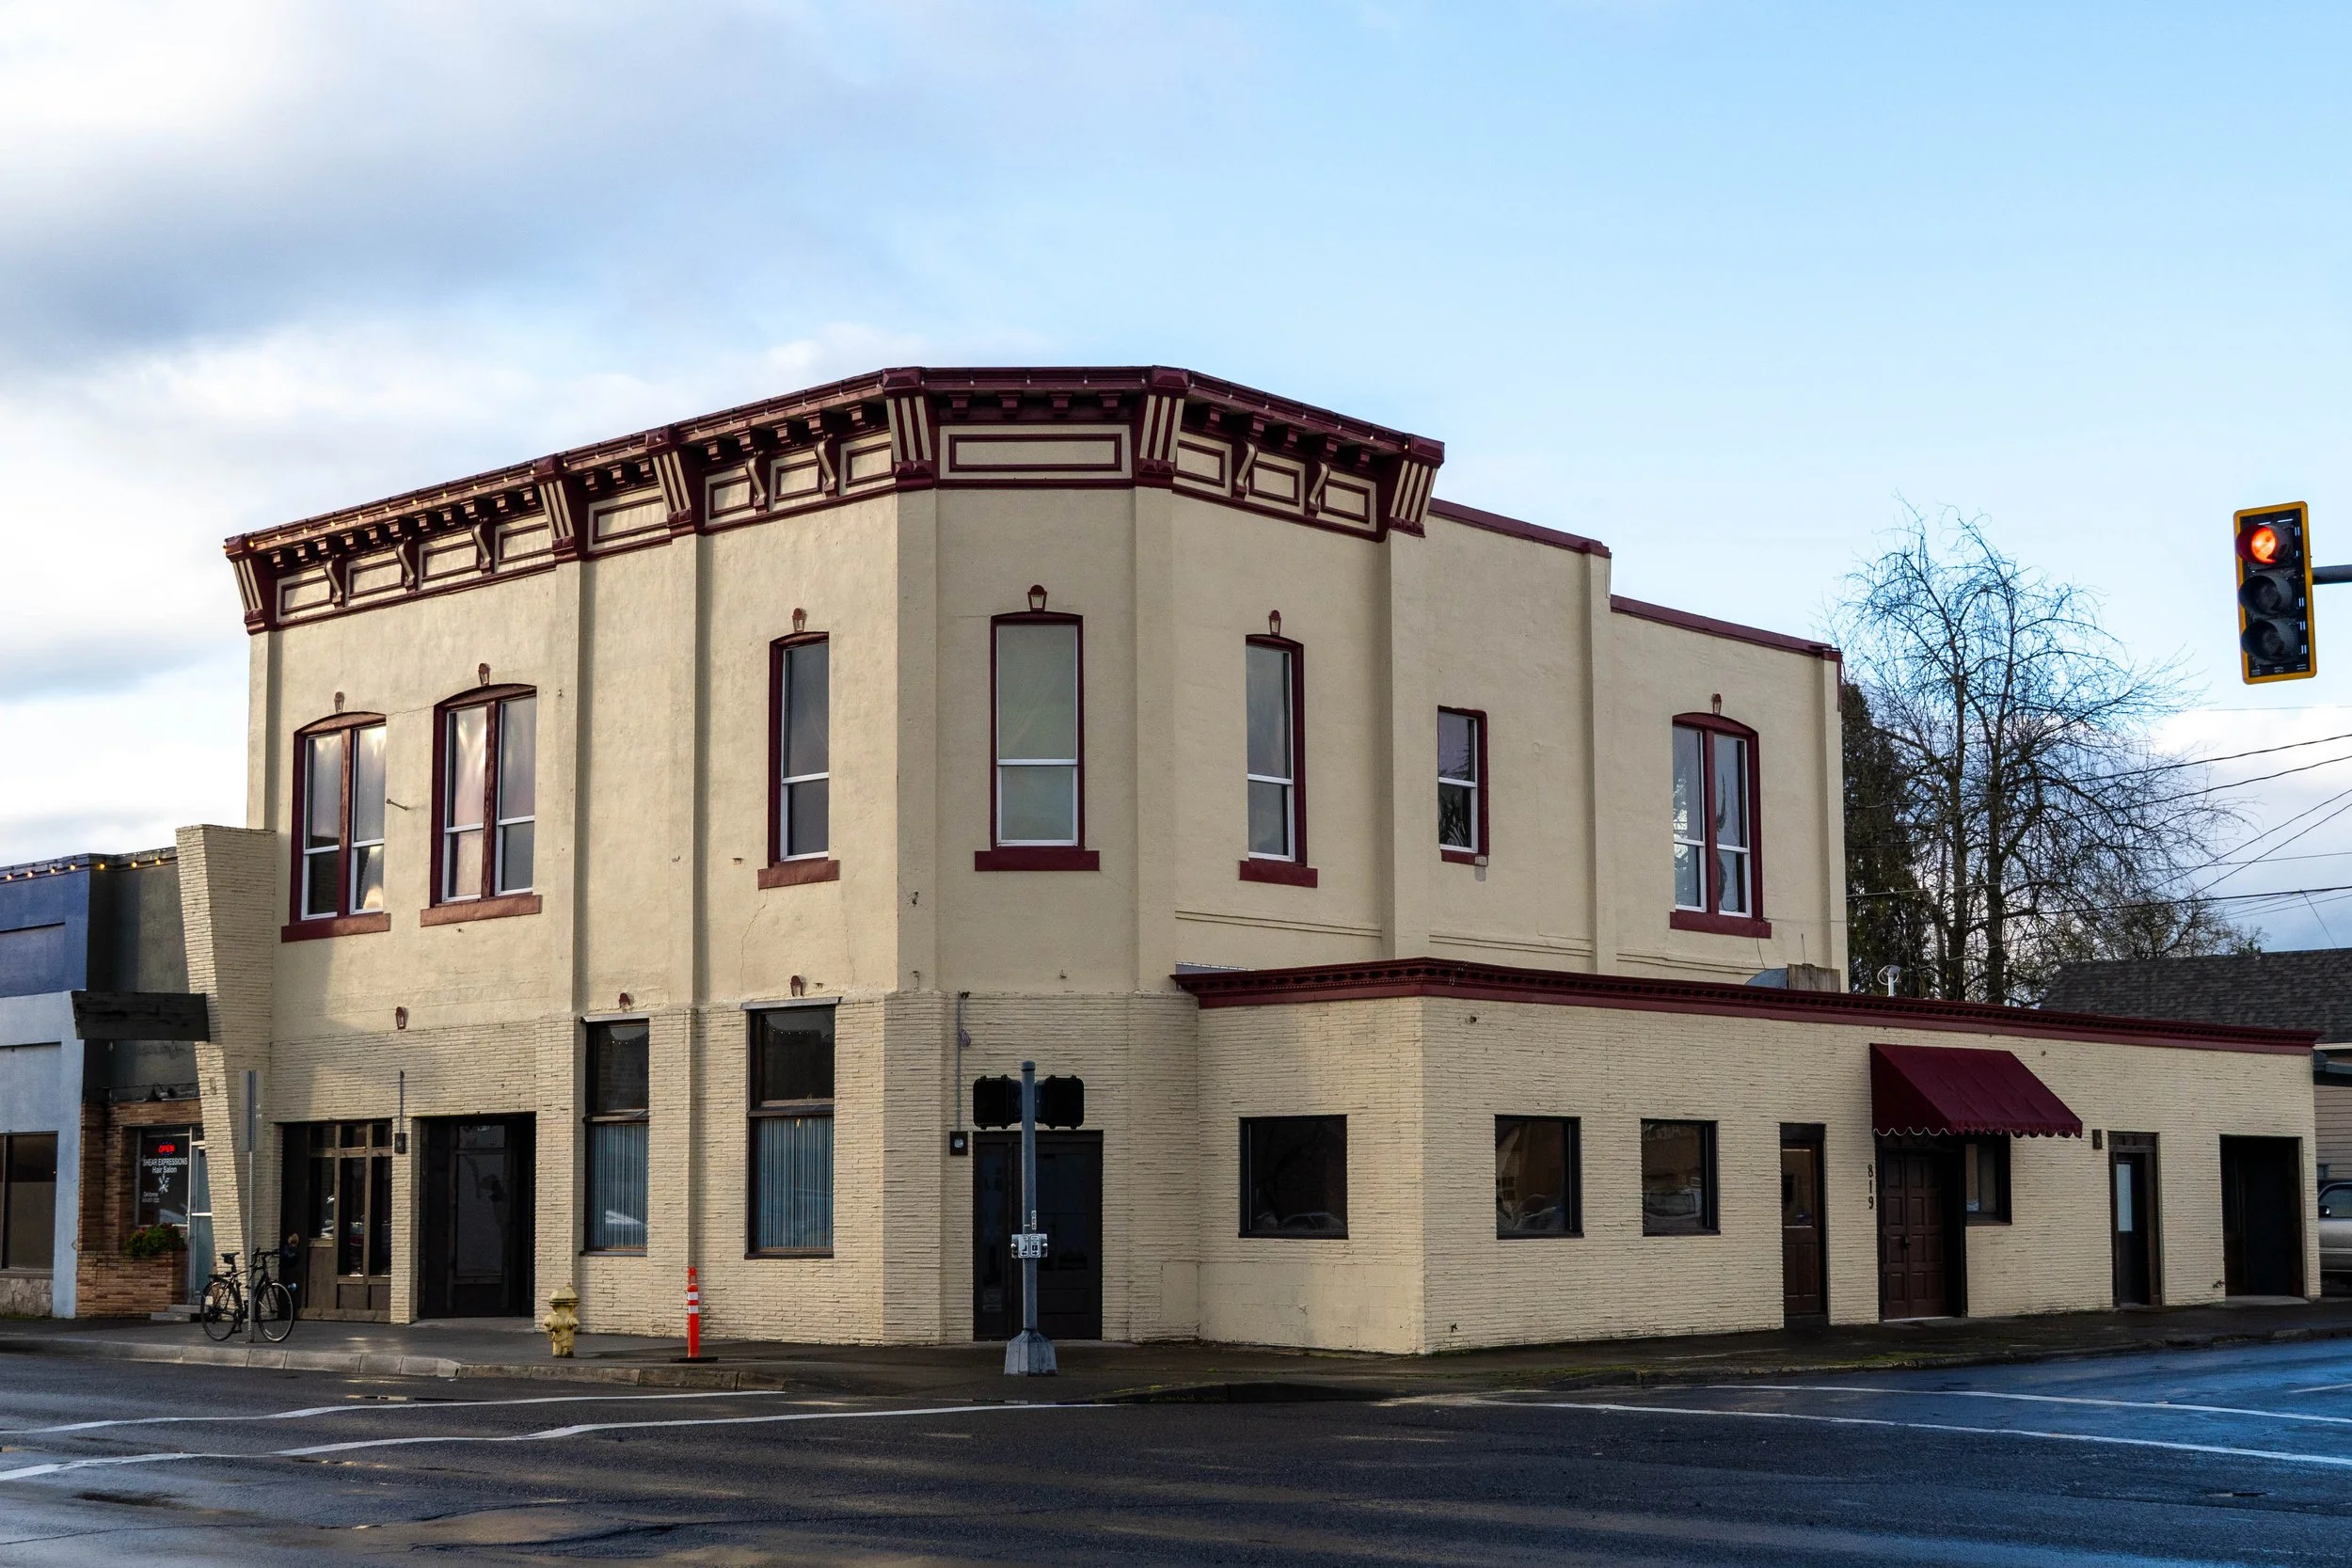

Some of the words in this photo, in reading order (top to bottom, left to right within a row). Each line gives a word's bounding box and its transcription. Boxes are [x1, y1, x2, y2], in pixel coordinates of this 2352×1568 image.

[158, 1145, 175, 1153] OPEN
[143, 1158, 157, 1166] SHEAR
[158, 1157, 188, 1166] EXPRESSIONS
